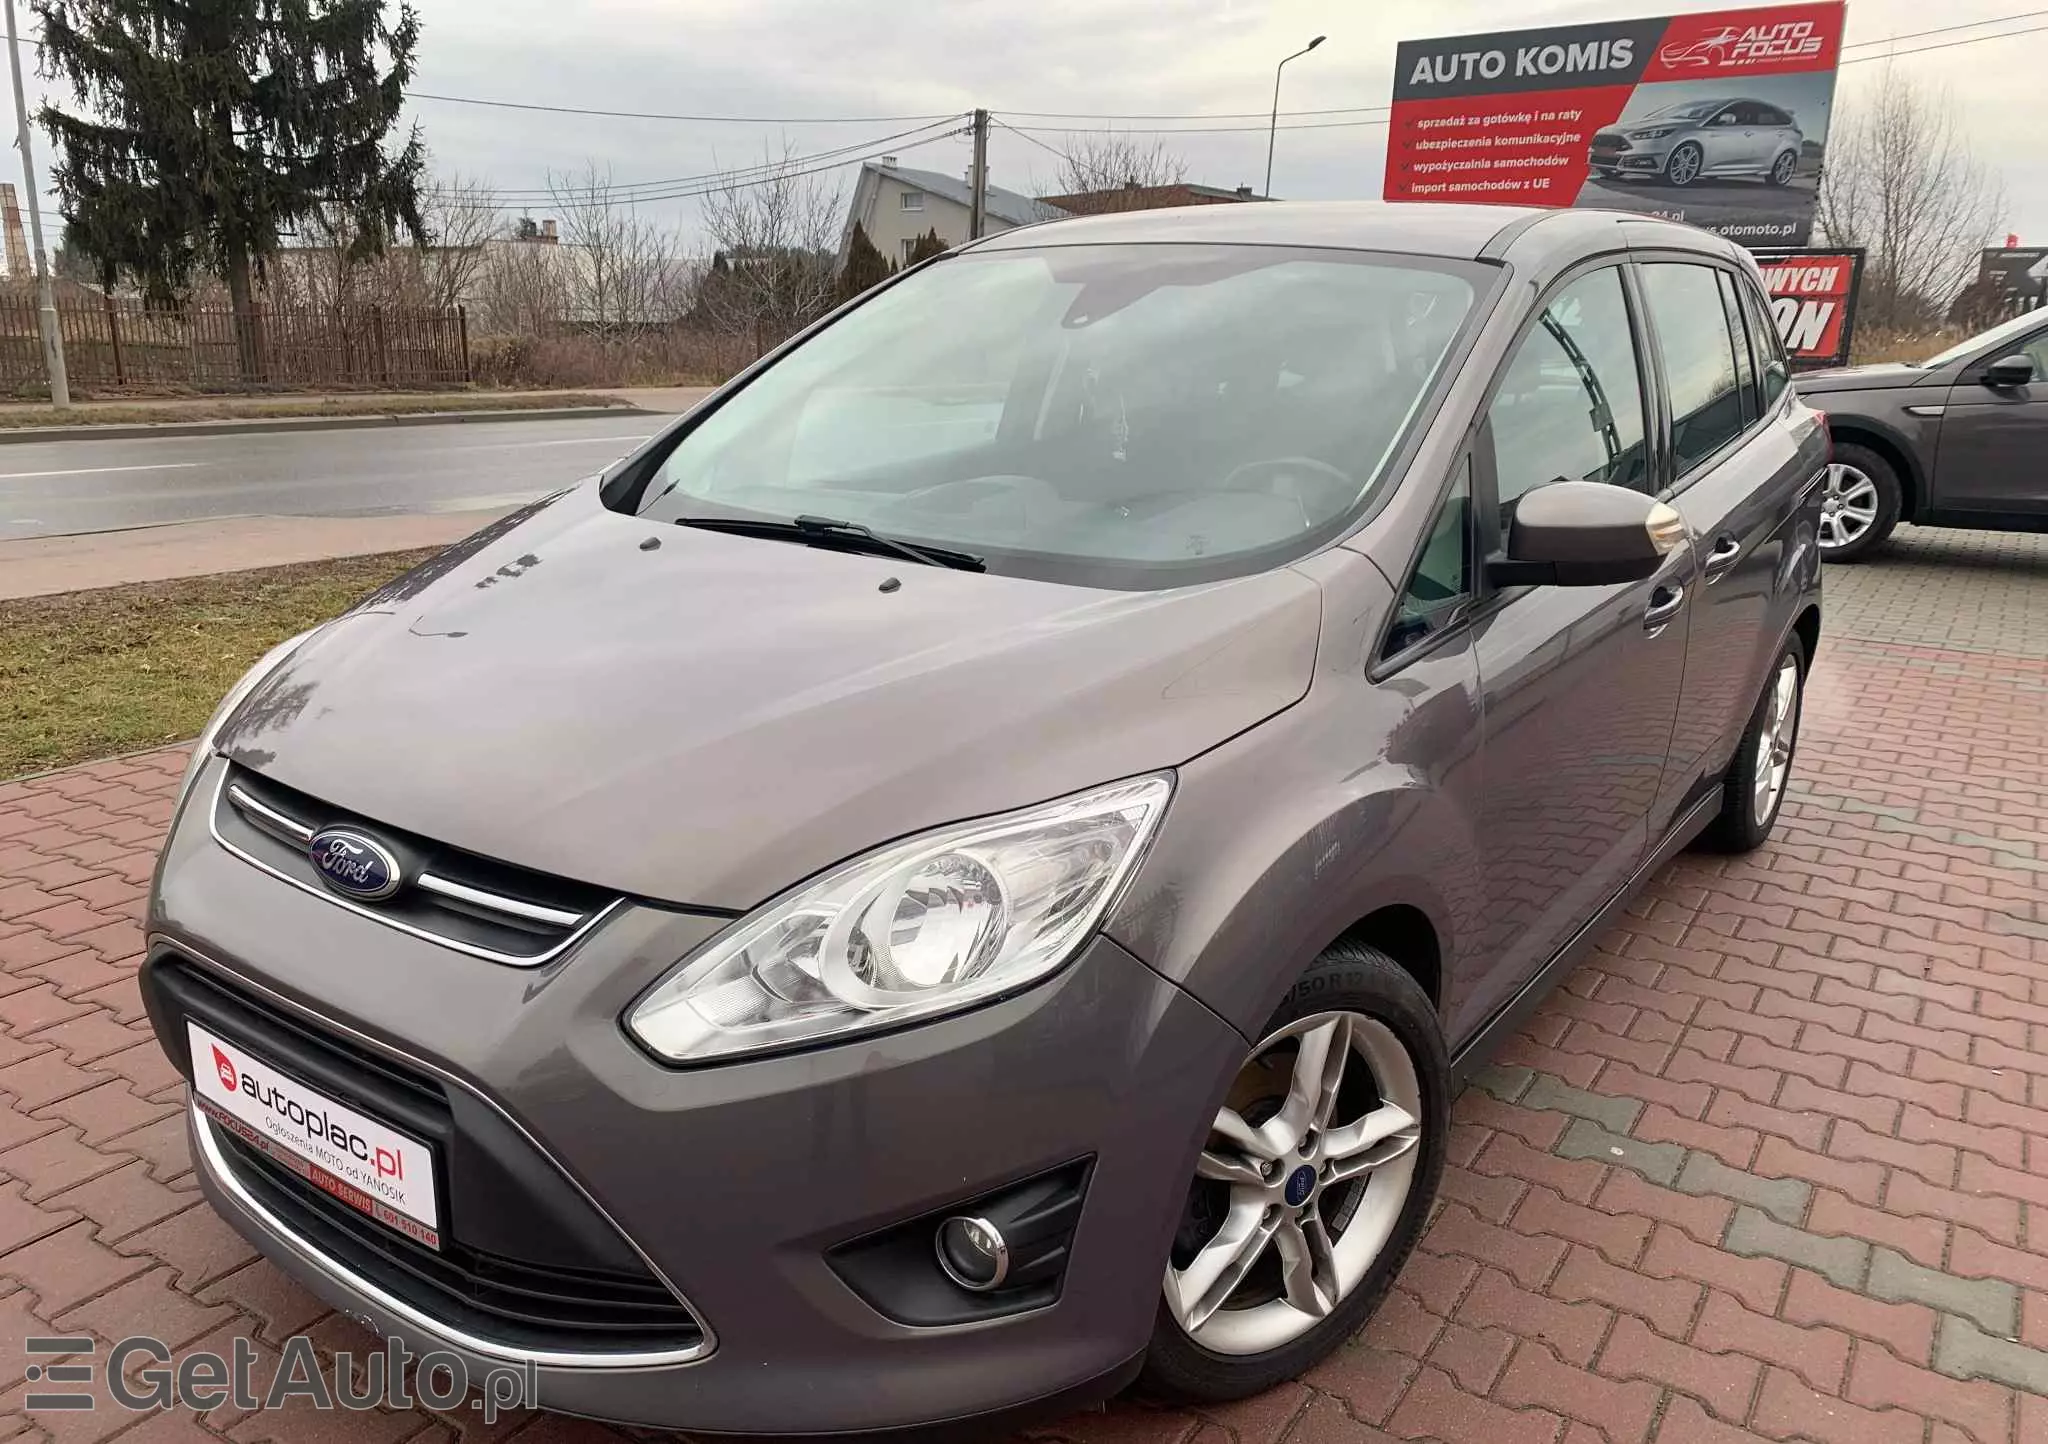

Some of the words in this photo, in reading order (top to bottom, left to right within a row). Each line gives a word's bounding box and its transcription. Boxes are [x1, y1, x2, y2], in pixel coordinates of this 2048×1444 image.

[1738, 21, 1814, 42] AUTO
[1731, 37, 1824, 59] FOCUS
[1409, 50, 1506, 85] AUTO
[1515, 38, 1634, 77] KOMIS
[1417, 115, 1465, 130] sprzedaż
[1467, 116, 1480, 126] za
[1483, 111, 1532, 127] gotówkę
[1541, 111, 1555, 121] na
[1558, 109, 1582, 122] raty
[1416, 135, 1491, 152] ubezpieczenia
[1494, 132, 1581, 147] komunikacyjne
[1414, 157, 1491, 173] wypożyczalnia
[1494, 155, 1569, 168] samochodów
[1412, 182, 1447, 195] import
[1449, 179, 1522, 192] samochodów
[1523, 181, 1530, 190] z
[1533, 178, 1550, 189] UE
[321, 838, 375, 884] Ford
[242, 1072, 403, 1181] autoplac.pl
[265, 1116, 313, 1153] Ogłoszenia
[316, 1145, 343, 1171] MOTO
[346, 1165, 359, 1180] od
[360, 1171, 406, 1205] YANOSIK
[312, 1169, 336, 1192] AUTO
[338, 1183, 372, 1211] SERWIS
